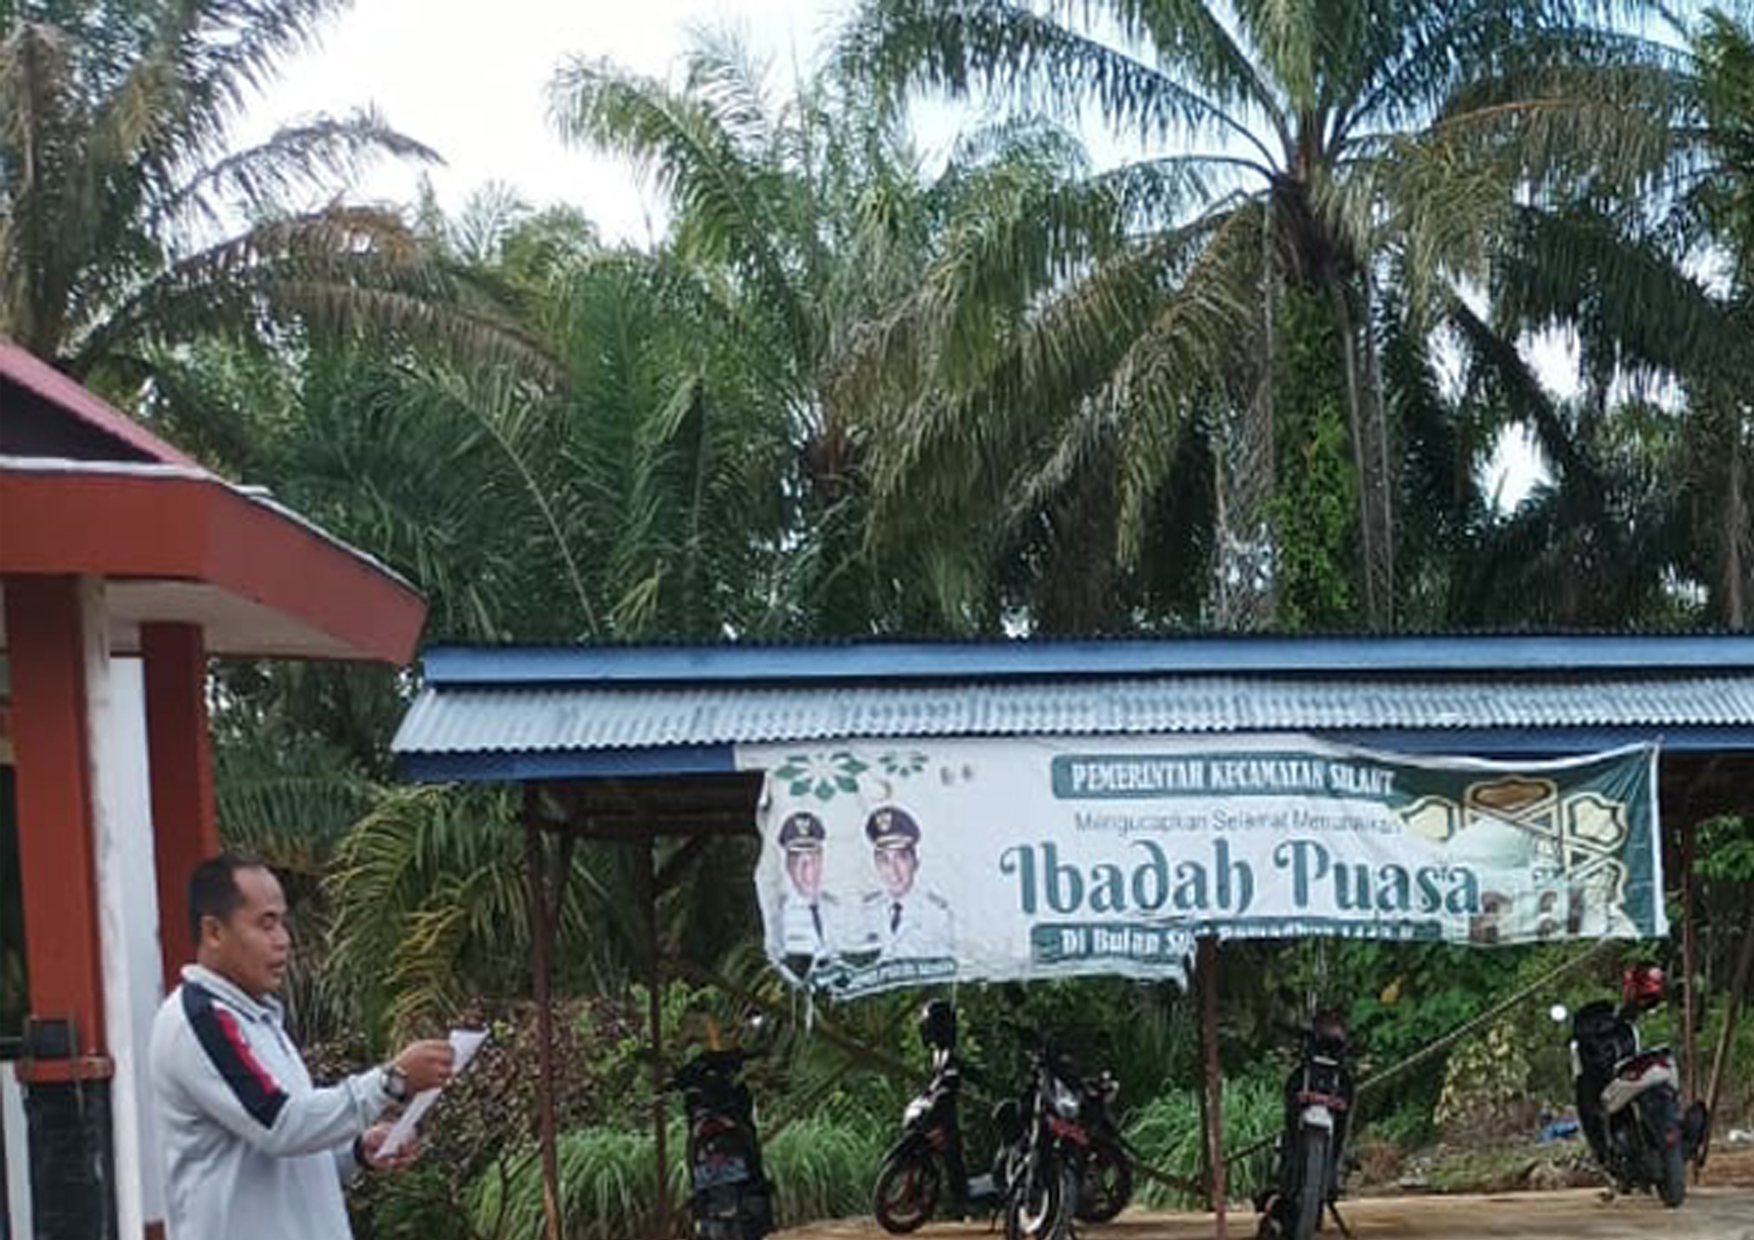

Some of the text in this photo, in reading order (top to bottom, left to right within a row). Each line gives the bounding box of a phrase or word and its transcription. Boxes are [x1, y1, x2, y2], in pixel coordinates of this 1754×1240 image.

[1071, 760, 1396, 795] PEMERINTAH KECAMATAN SILAUT
[1001, 838, 1480, 915] Ibadah Puasa
[1061, 929, 1086, 955] Di
[1092, 928, 1160, 955] Bulan
